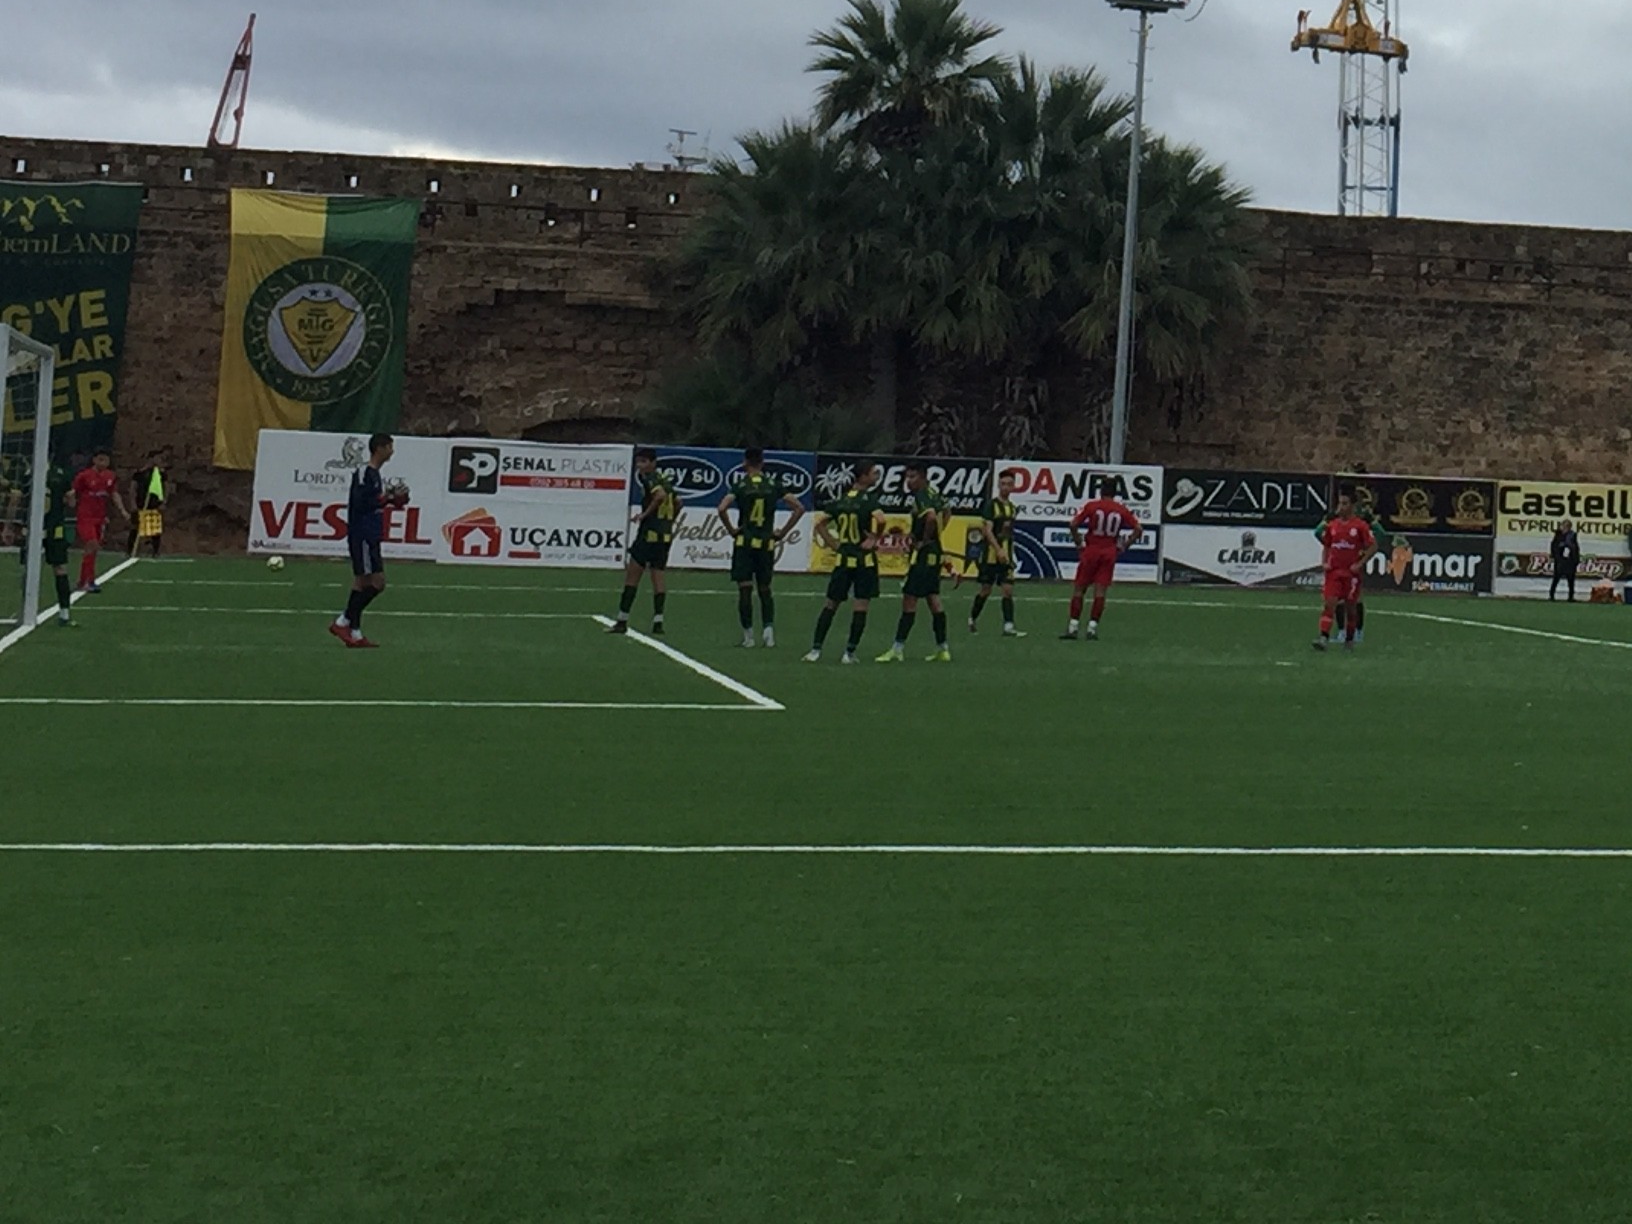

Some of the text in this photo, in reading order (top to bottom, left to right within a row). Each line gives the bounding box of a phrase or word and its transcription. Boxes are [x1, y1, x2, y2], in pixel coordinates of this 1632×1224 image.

[501, 456, 557, 472] ŞENAL
[691, 468, 716, 484] su
[781, 472, 805, 487] su
[258, 500, 432, 545] VESEL
[749, 497, 766, 528] 4
[1092, 508, 1122, 538] 10
[836, 513, 861, 545] 20
[1507, 518, 1560, 534] CYPRU
[509, 527, 624, 552] UÇANOK
